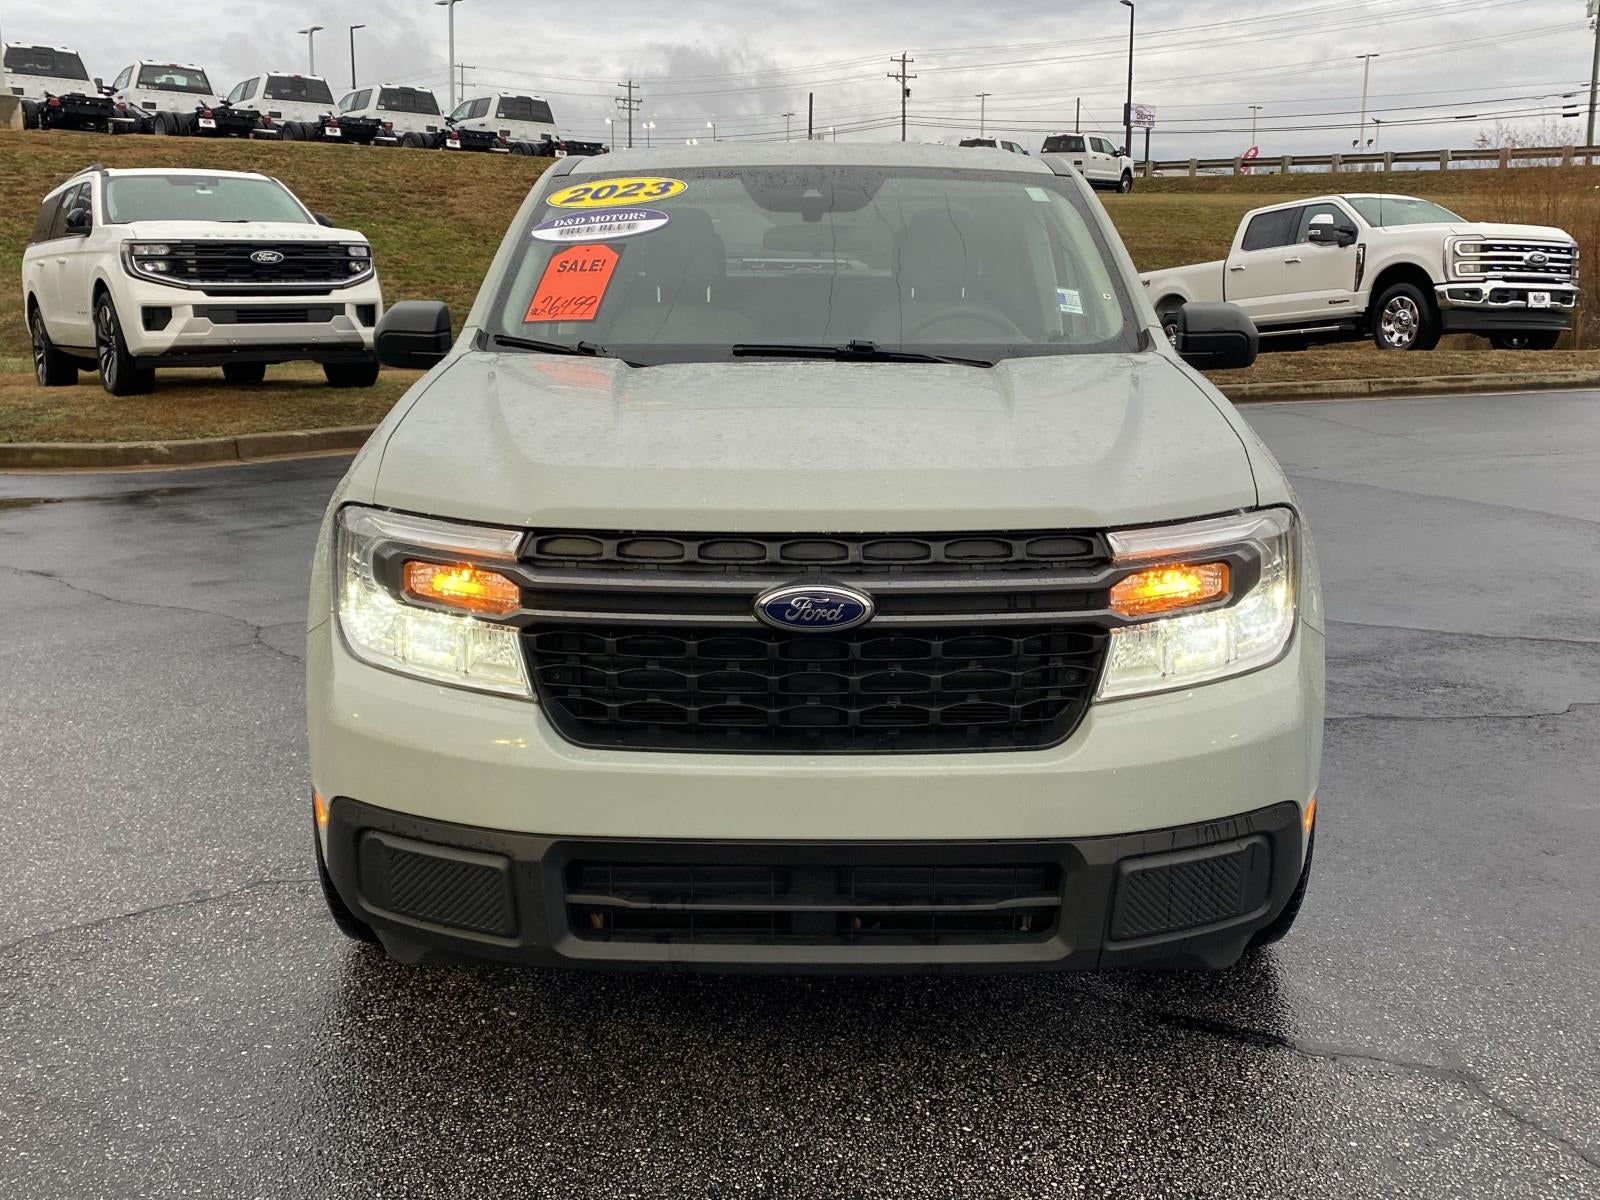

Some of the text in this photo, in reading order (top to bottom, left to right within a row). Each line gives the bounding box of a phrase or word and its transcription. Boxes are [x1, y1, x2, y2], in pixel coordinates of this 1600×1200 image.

[1136, 113, 1155, 122] DEPOT
[560, 181, 676, 204] 2023
[553, 212, 647, 228] D&D MOTORS
[256, 252, 278, 262] Ford
[556, 259, 607, 273] SALE!
[784, 596, 845, 621] Ford
